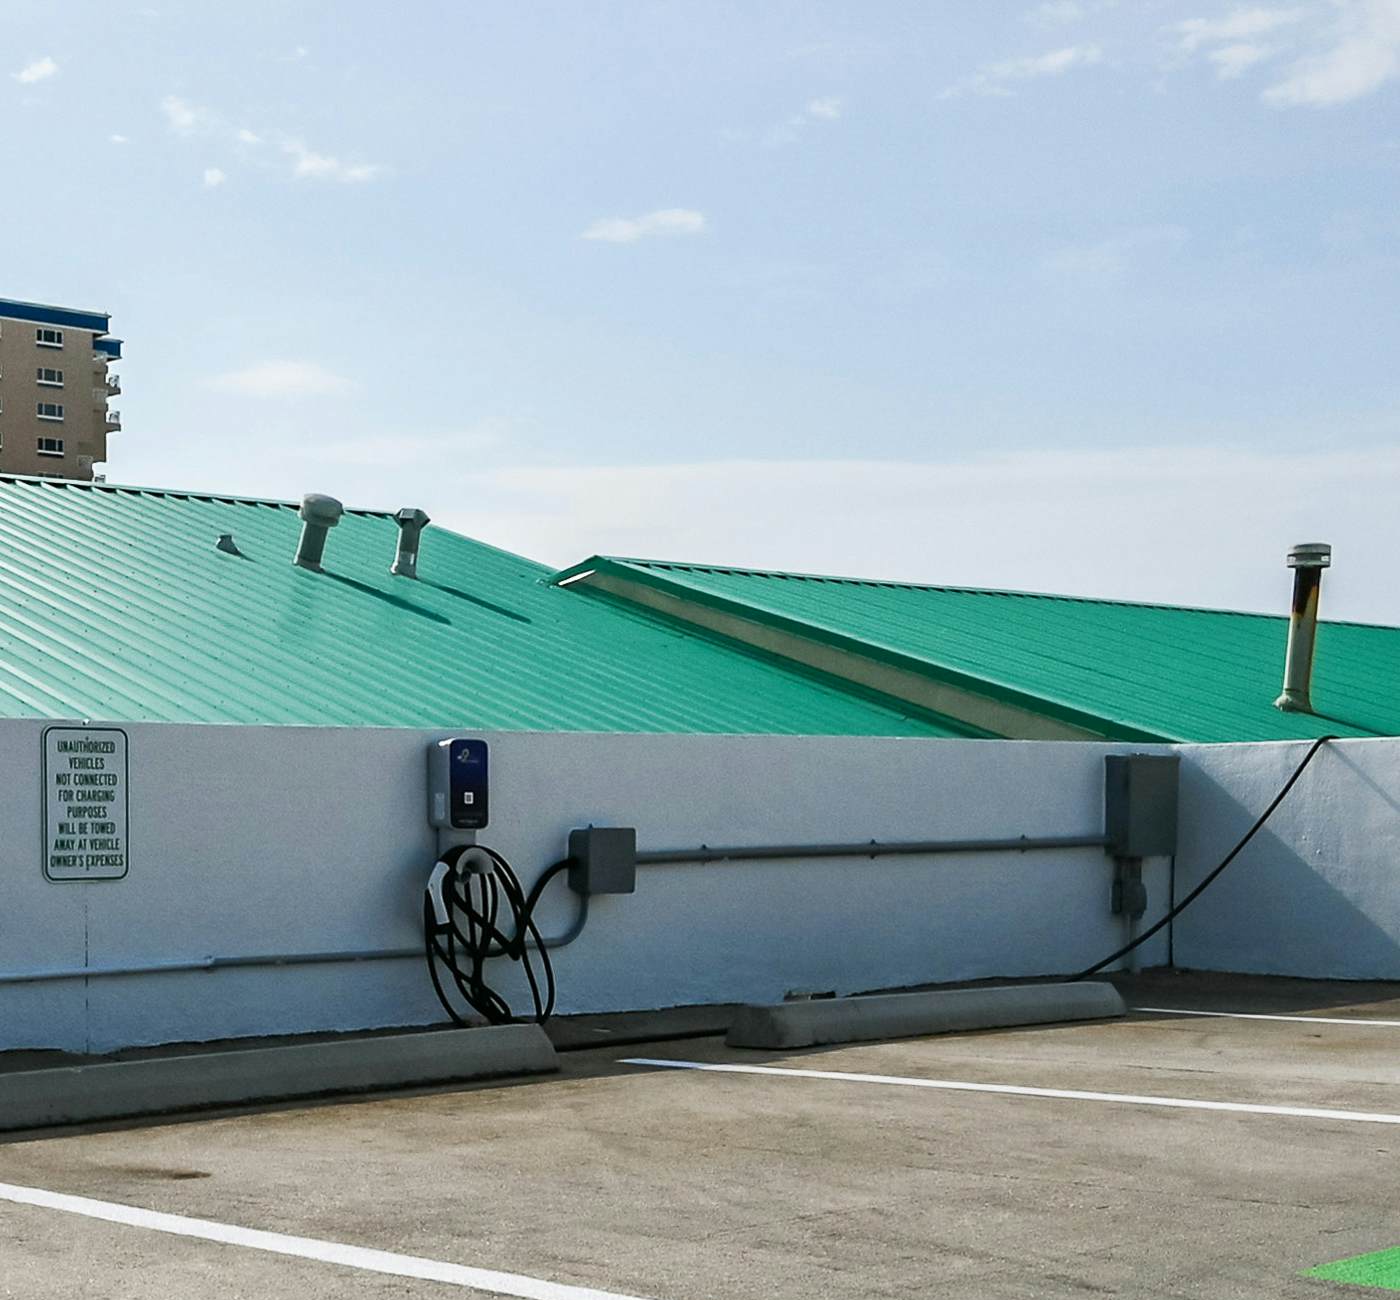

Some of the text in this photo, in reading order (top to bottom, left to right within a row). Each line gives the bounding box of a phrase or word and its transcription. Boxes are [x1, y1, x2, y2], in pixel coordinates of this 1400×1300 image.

[57, 740, 116, 754] UNAUTHORIZED
[69, 757, 104, 770] VEHICLES
[56, 773, 118, 786] NOT CONNECTED
[58, 789, 115, 802] FOR CHARGING
[67, 806, 107, 819] PURPOSES
[58, 822, 116, 834] WILL BE TOWED
[54, 838, 120, 851] AWAY AT VEHICLE
[50, 854, 124, 868] OWNER'S EXPENSES
